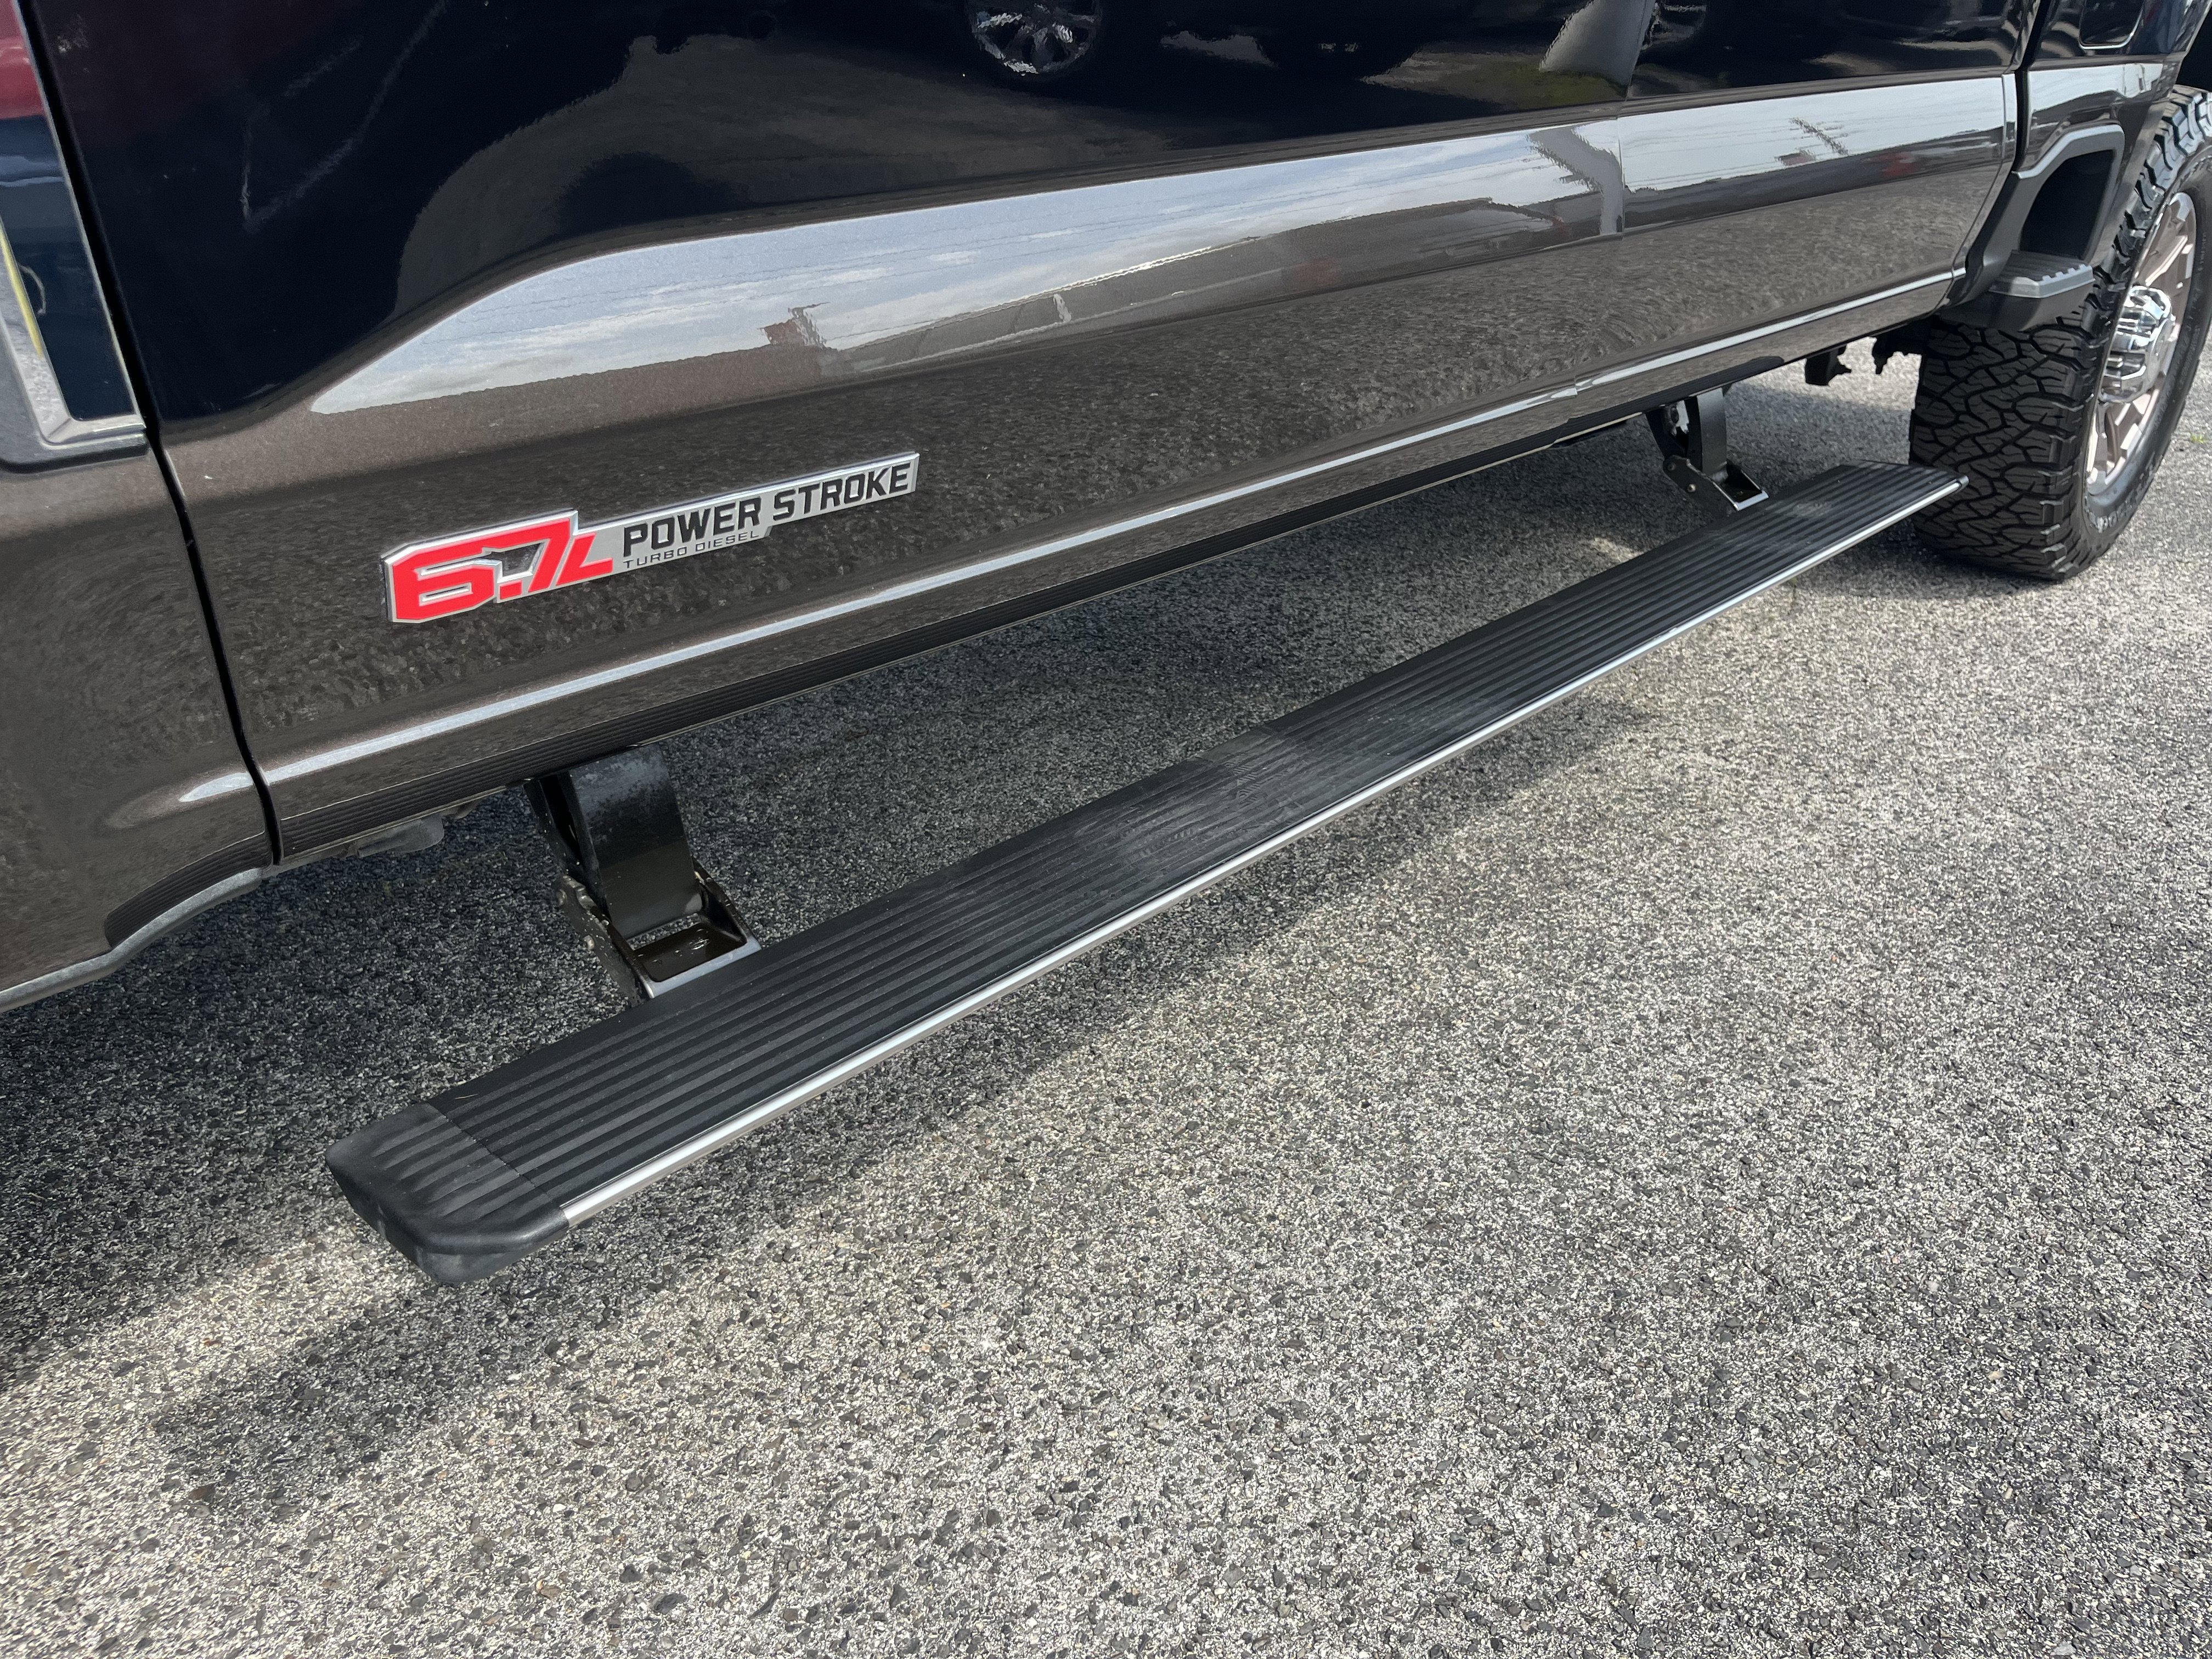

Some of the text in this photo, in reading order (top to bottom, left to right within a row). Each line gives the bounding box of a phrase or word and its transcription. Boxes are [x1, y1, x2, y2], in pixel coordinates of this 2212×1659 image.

[391, 462, 911, 620] 6.7L POWER STROKE
[623, 531, 759, 569] TURBO DIESEL
